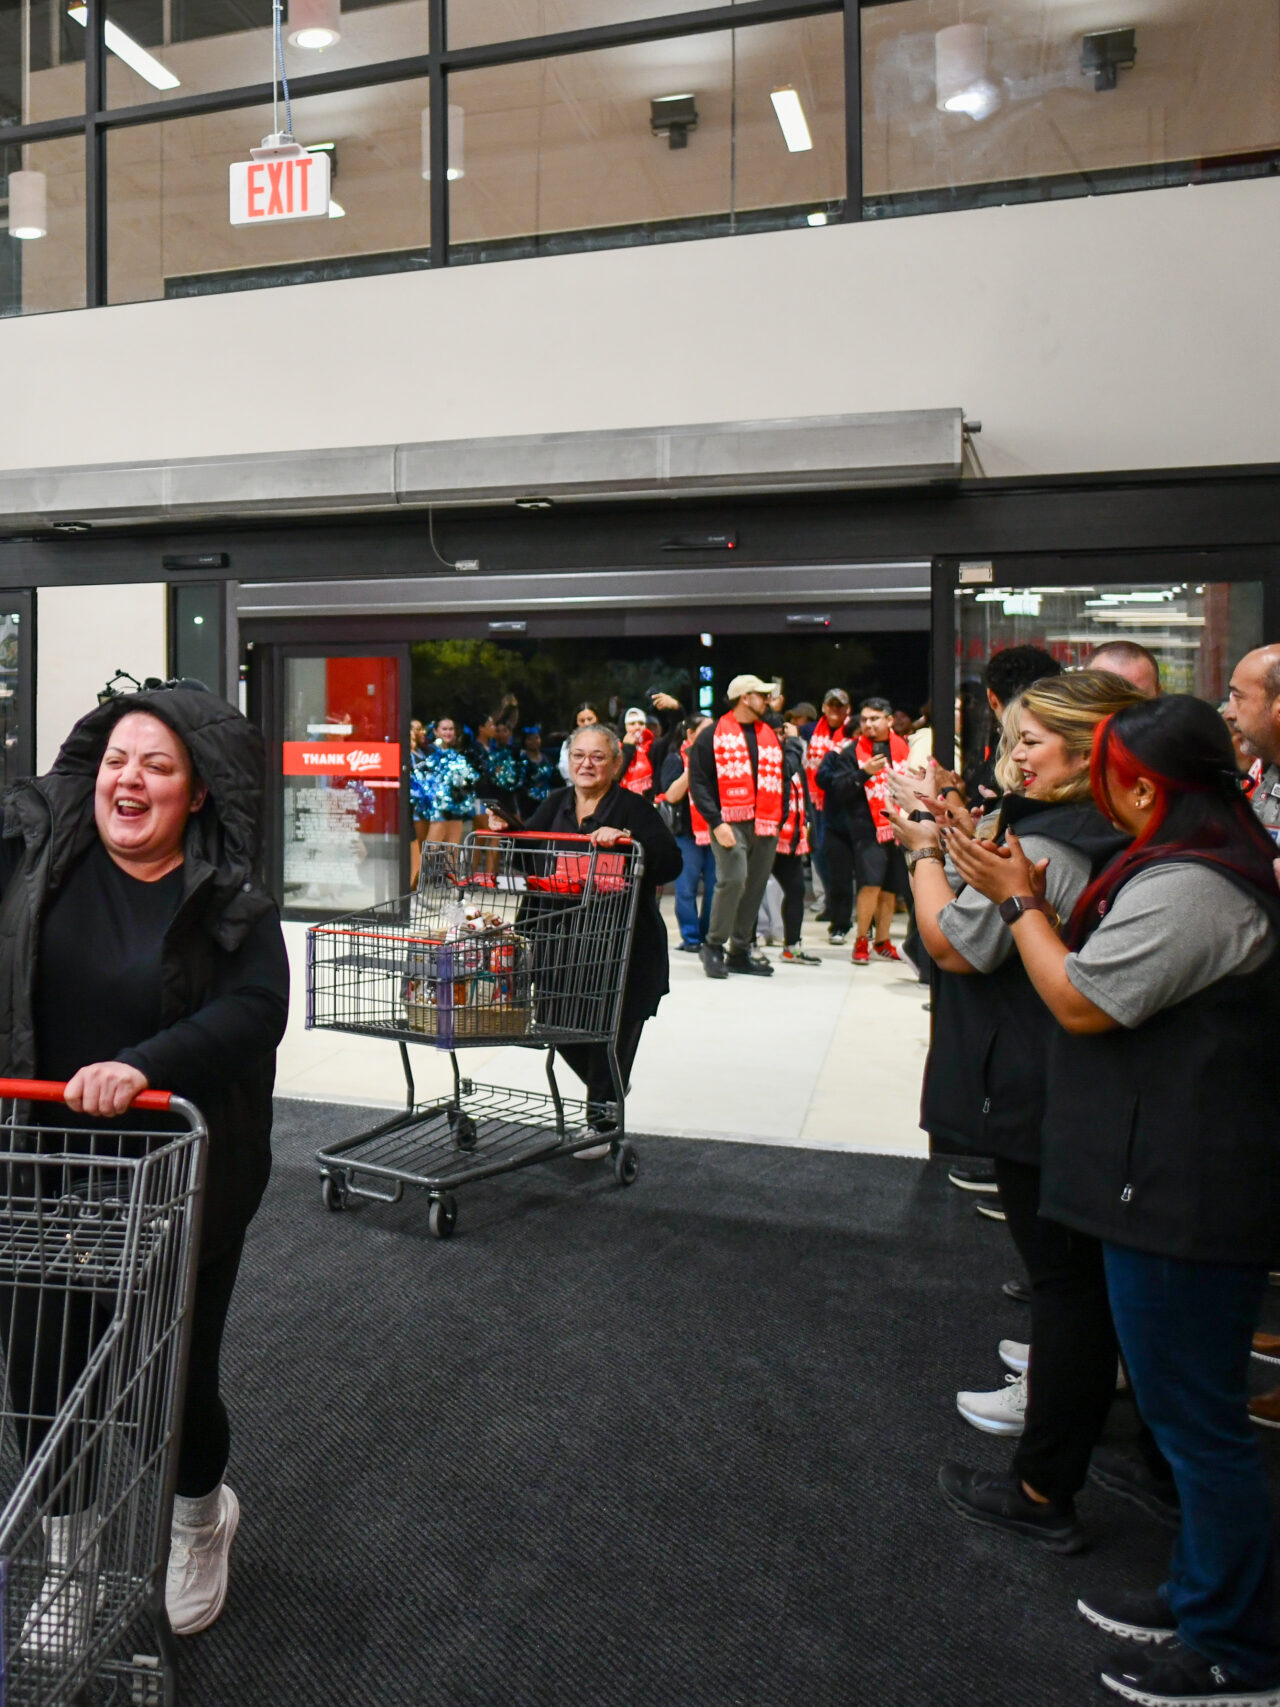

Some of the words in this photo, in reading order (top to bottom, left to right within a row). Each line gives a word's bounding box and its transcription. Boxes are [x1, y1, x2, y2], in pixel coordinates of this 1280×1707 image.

[248, 158, 313, 217] EXIT
[302, 753, 345, 765] THANK
[346, 750, 381, 772] You
